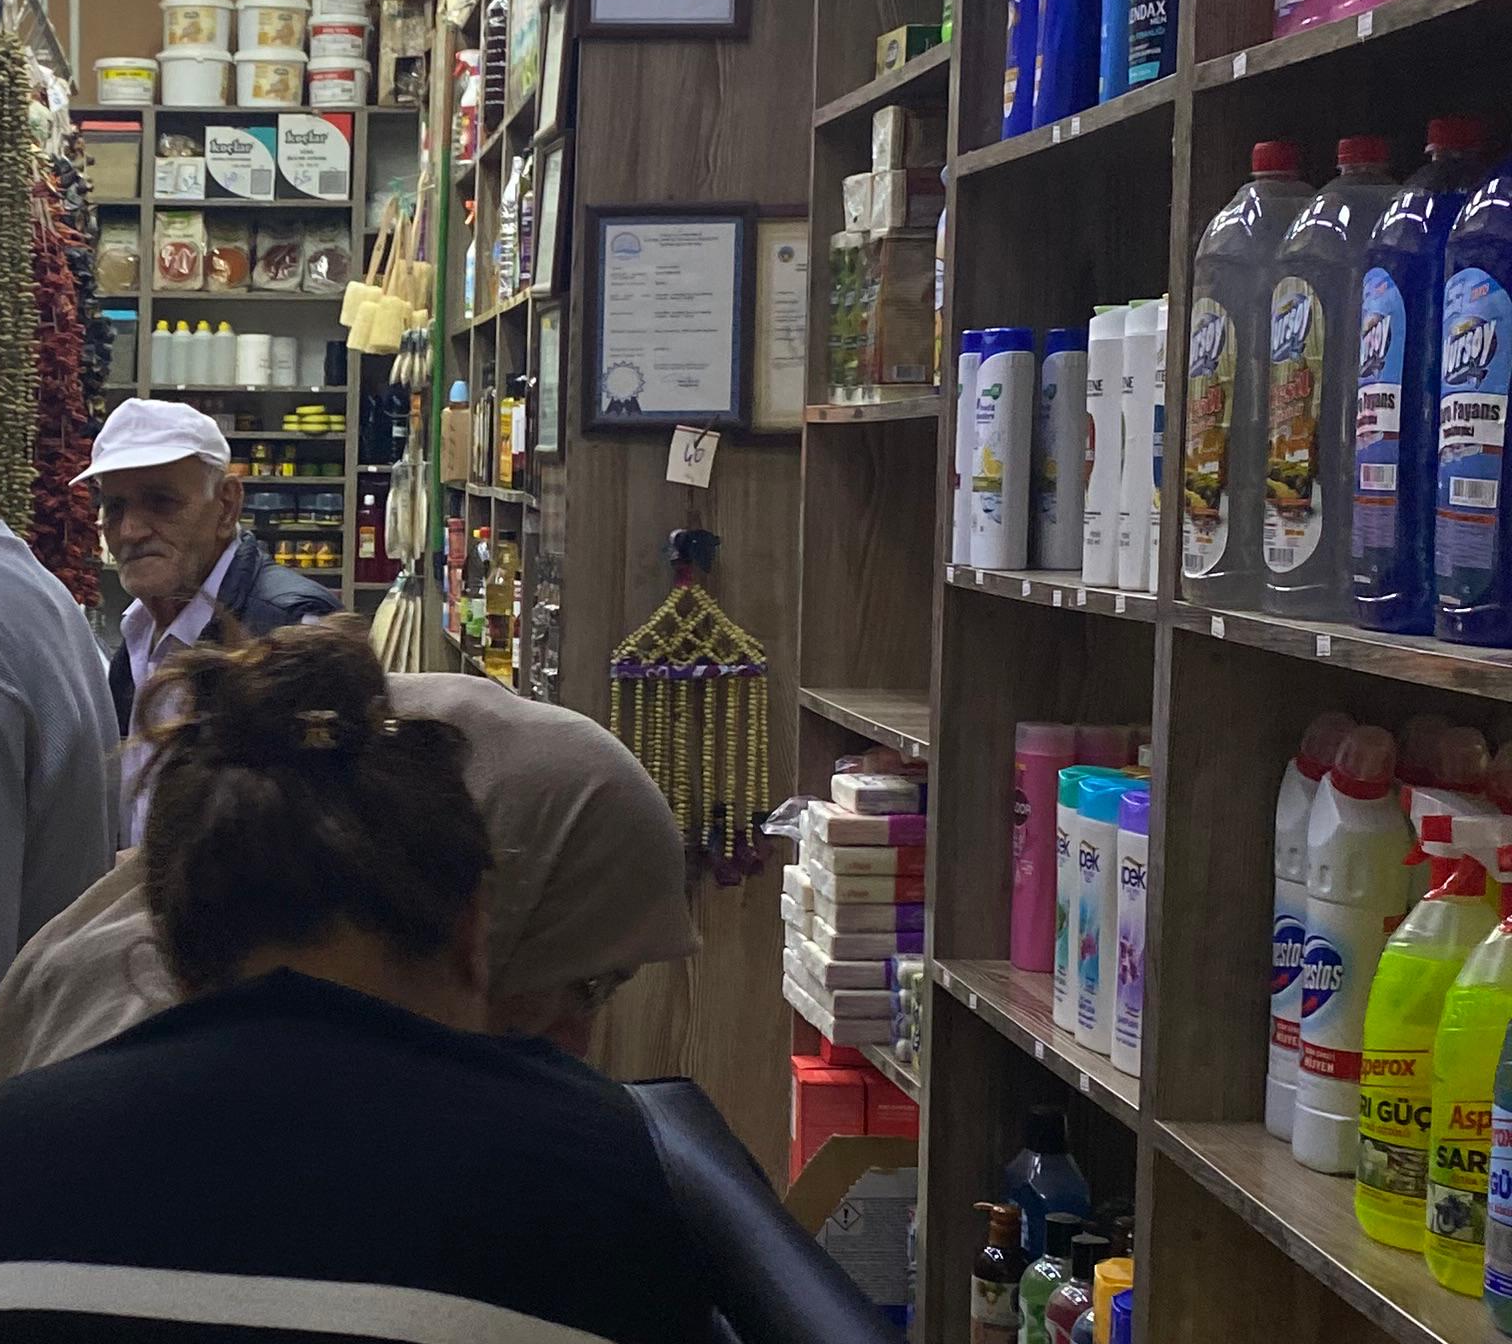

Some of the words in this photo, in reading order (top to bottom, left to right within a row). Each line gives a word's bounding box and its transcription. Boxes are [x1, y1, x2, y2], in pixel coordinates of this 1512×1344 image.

[1129, 0, 1166, 25] ENDAX
[210, 138, 253, 156] koçlar
[285, 129, 328, 146] koçlar
[1453, 400, 1501, 422] Fayans
[1079, 844, 1101, 874] pek
[1272, 937, 1305, 967] esto
[1304, 959, 1343, 992] estos
[1361, 1058, 1416, 1081] perox
[1436, 1144, 1487, 1174] SAR
[1491, 1168, 1512, 1199] GÜ
